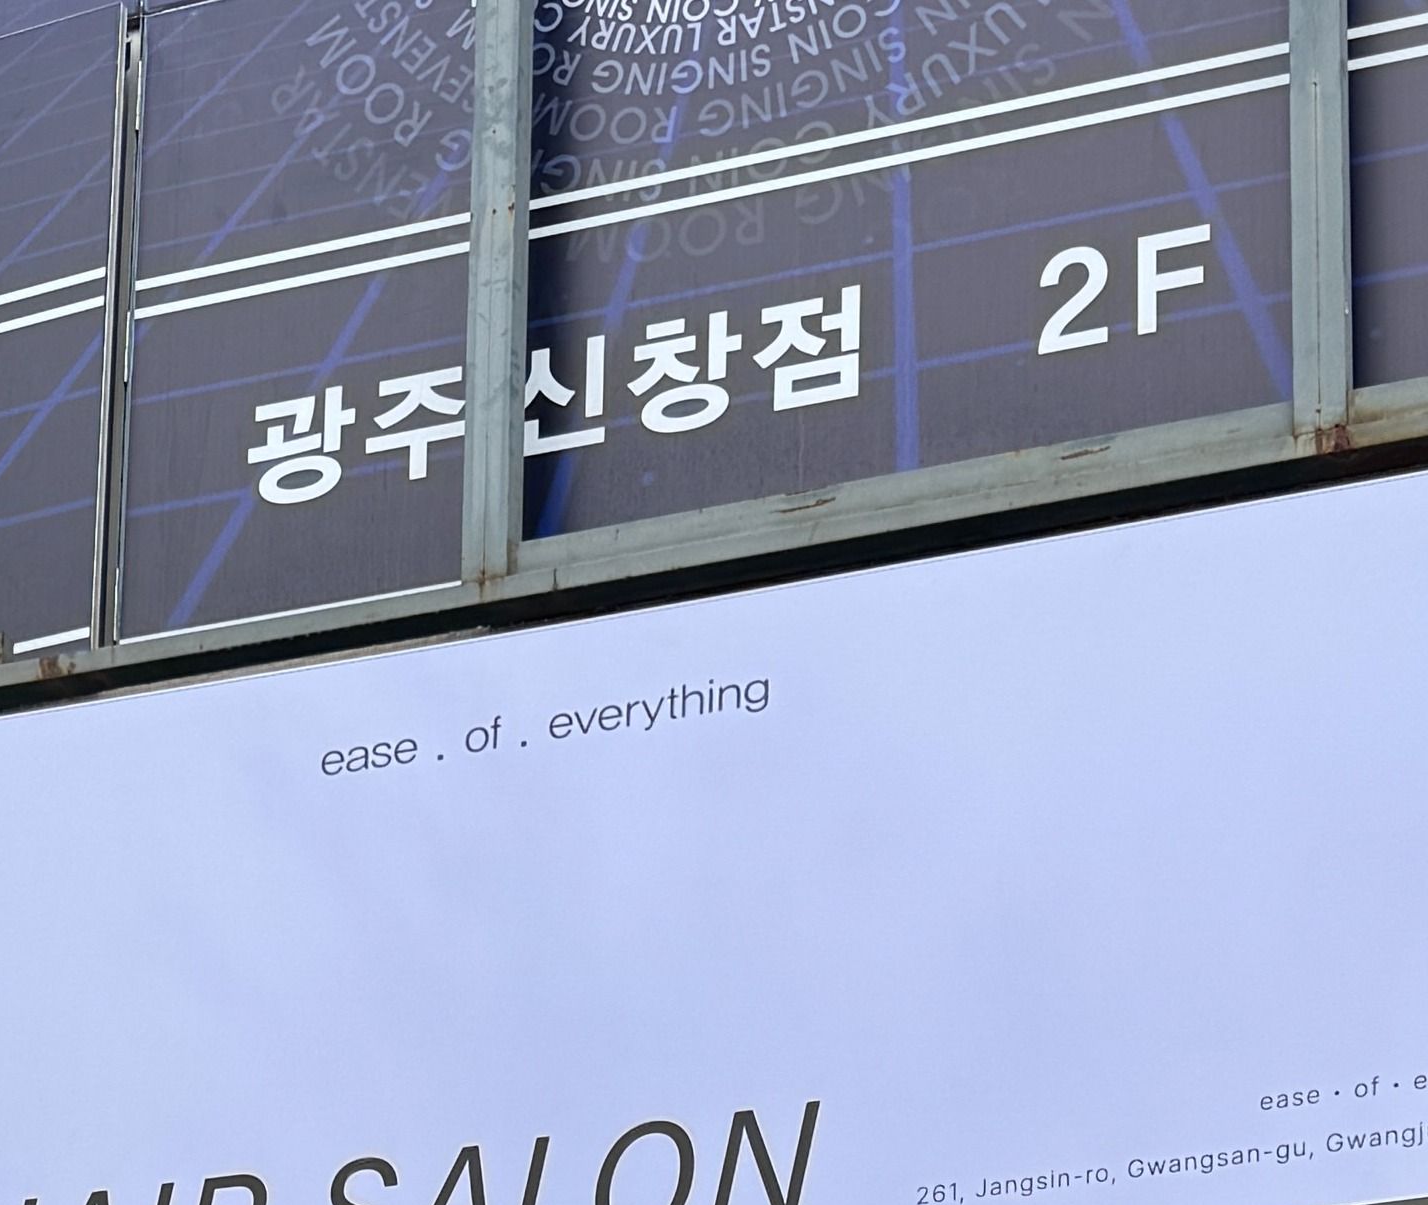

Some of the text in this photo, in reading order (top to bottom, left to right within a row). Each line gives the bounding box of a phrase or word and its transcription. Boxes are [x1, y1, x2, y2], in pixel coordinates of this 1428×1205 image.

[567, 15, 702, 54] LUXURY
[305, 14, 433, 148] ROOM
[591, 44, 771, 96] SINGING
[698, 27, 907, 137] SINGING
[533, 92, 678, 144] ROOM
[247, 223, 1212, 505] 광주신창점 2F
[321, 738, 418, 776] ease
[465, 716, 502, 753] of
[549, 678, 770, 739] everything
[1260, 1087, 1321, 1111] ease
[1354, 1075, 1380, 1099] of
[917, 1181, 965, 1205] 261,
[975, 1165, 1116, 1198] Jangsin-ro,
[1127, 1139, 1315, 1180] Gwangsan-gu,
